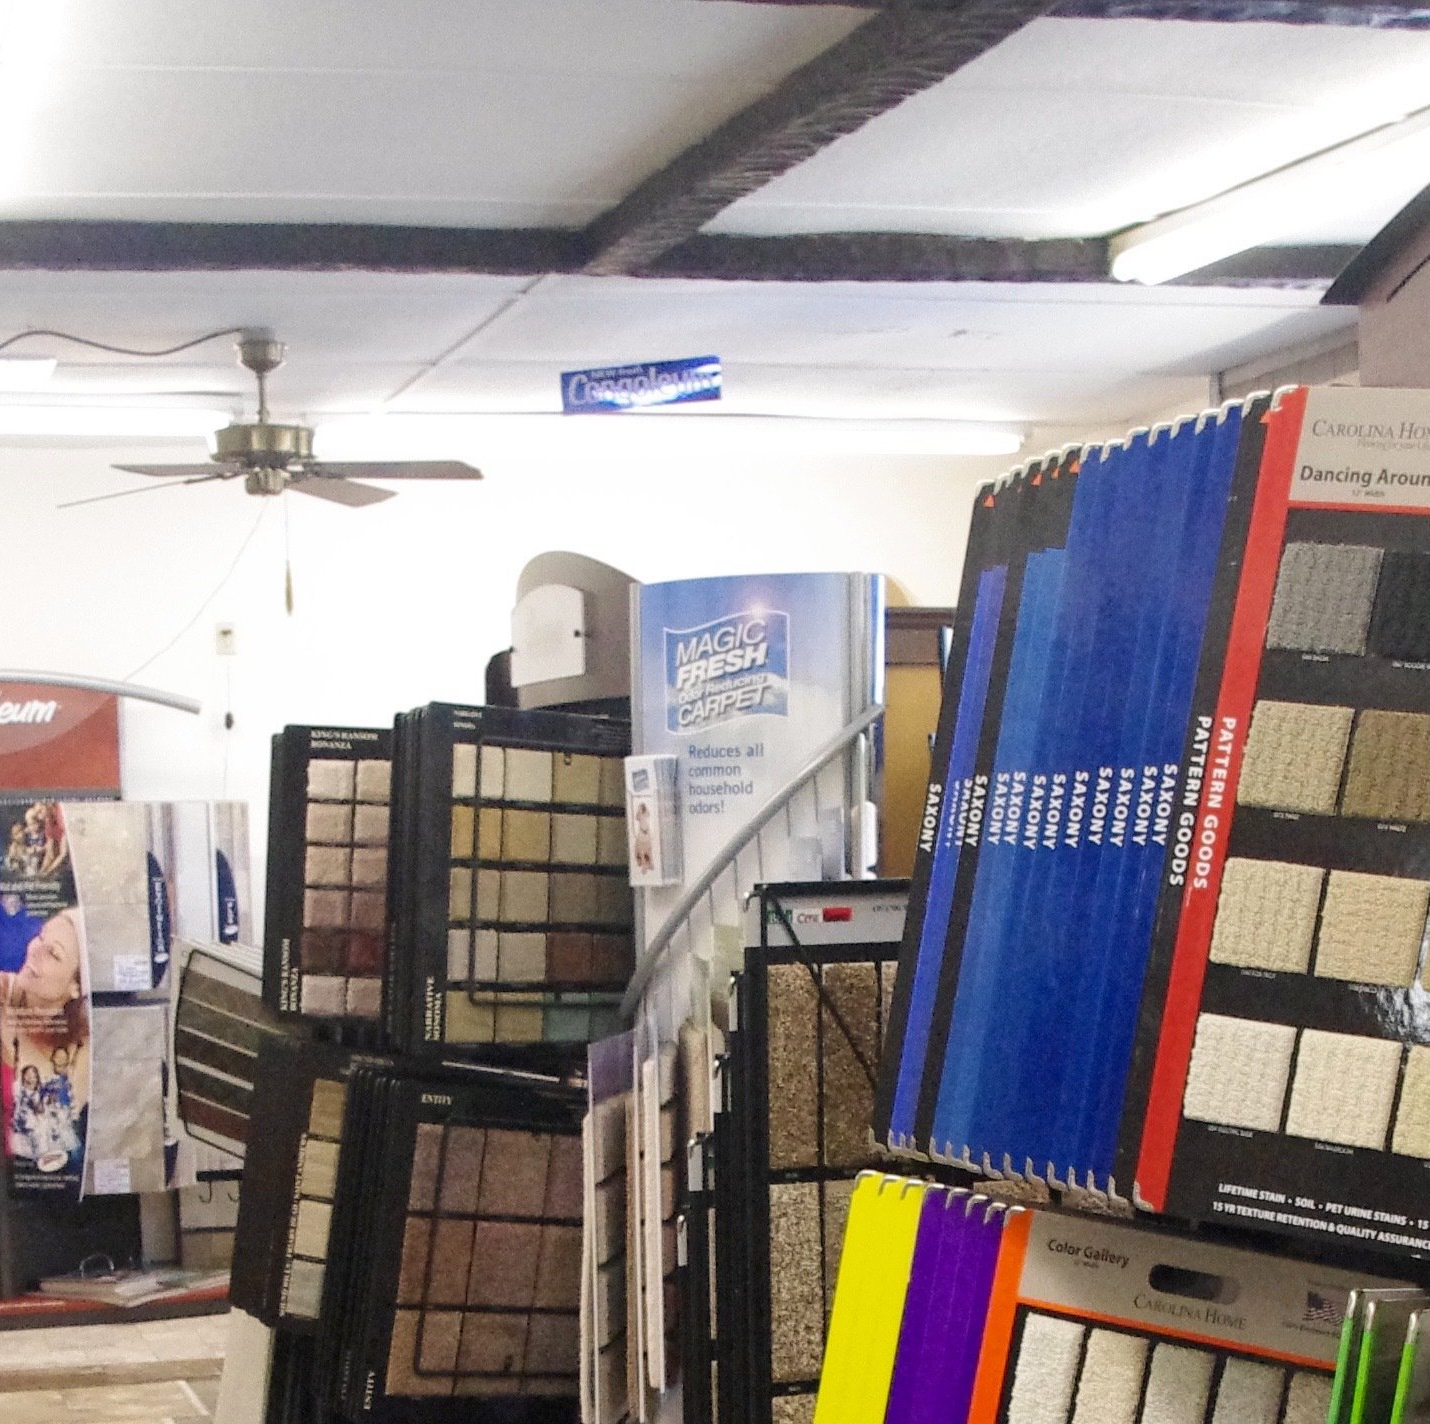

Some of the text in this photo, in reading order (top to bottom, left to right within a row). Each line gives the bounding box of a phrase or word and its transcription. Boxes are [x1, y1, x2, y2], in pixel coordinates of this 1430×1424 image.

[1312, 418, 1394, 440] CAROLINA
[1300, 465, 1372, 488] Dancing
[675, 619, 766, 668] MAGIC
[677, 643, 767, 691] FRESH
[679, 684, 771, 727] CARPET
[689, 742, 764, 759] Reduces all
[689, 764, 741, 777] common
[688, 800, 724, 815] odors!
[689, 781, 753, 796] household
[920, 783, 942, 852] SAXONY
[965, 774, 988, 847] SAXONY
[987, 772, 1010, 845] SAXONY
[1004, 771, 1027, 845] SAXONY
[1023, 775, 1047, 850] SAXONY
[1043, 774, 1067, 850] SAXONY
[1064, 771, 1090, 848] SAXONY
[1088, 766, 1114, 846] SAXONY
[1110, 768, 1135, 847] SAXONY
[1132, 766, 1158, 846] SAXONY
[1152, 764, 1178, 846] SAXONY
[1169, 715, 1213, 886] PATTERN GOODS
[1193, 717, 1237, 889] PATTERN GOODS
[424, 976, 435, 1041] NARRATIVE
[1213, 1201, 1223, 1212] 15
[1223, 1203, 1236, 1214] YR
[1236, 1205, 1275, 1222] TEXTURE
[1276, 1211, 1328, 1232] RETENTION
[1328, 1221, 1336, 1233] &
[1336, 1223, 1377, 1241] QUALITY
[1218, 1183, 1258, 1200] LIFETIME
[1259, 1189, 1286, 1204] STAIN
[1294, 1196, 1316, 1209] SOIL
[1325, 1202, 1343, 1214] PET
[1344, 1205, 1372, 1220] URINE
[1373, 1210, 1407, 1226] STAINS
[1418, 1219, 1429, 1230] 15
[1048, 1238, 1082, 1256] Color
[1083, 1246, 1129, 1269] Gallery
[1133, 1293, 1247, 1331] CAROLINA HOME
